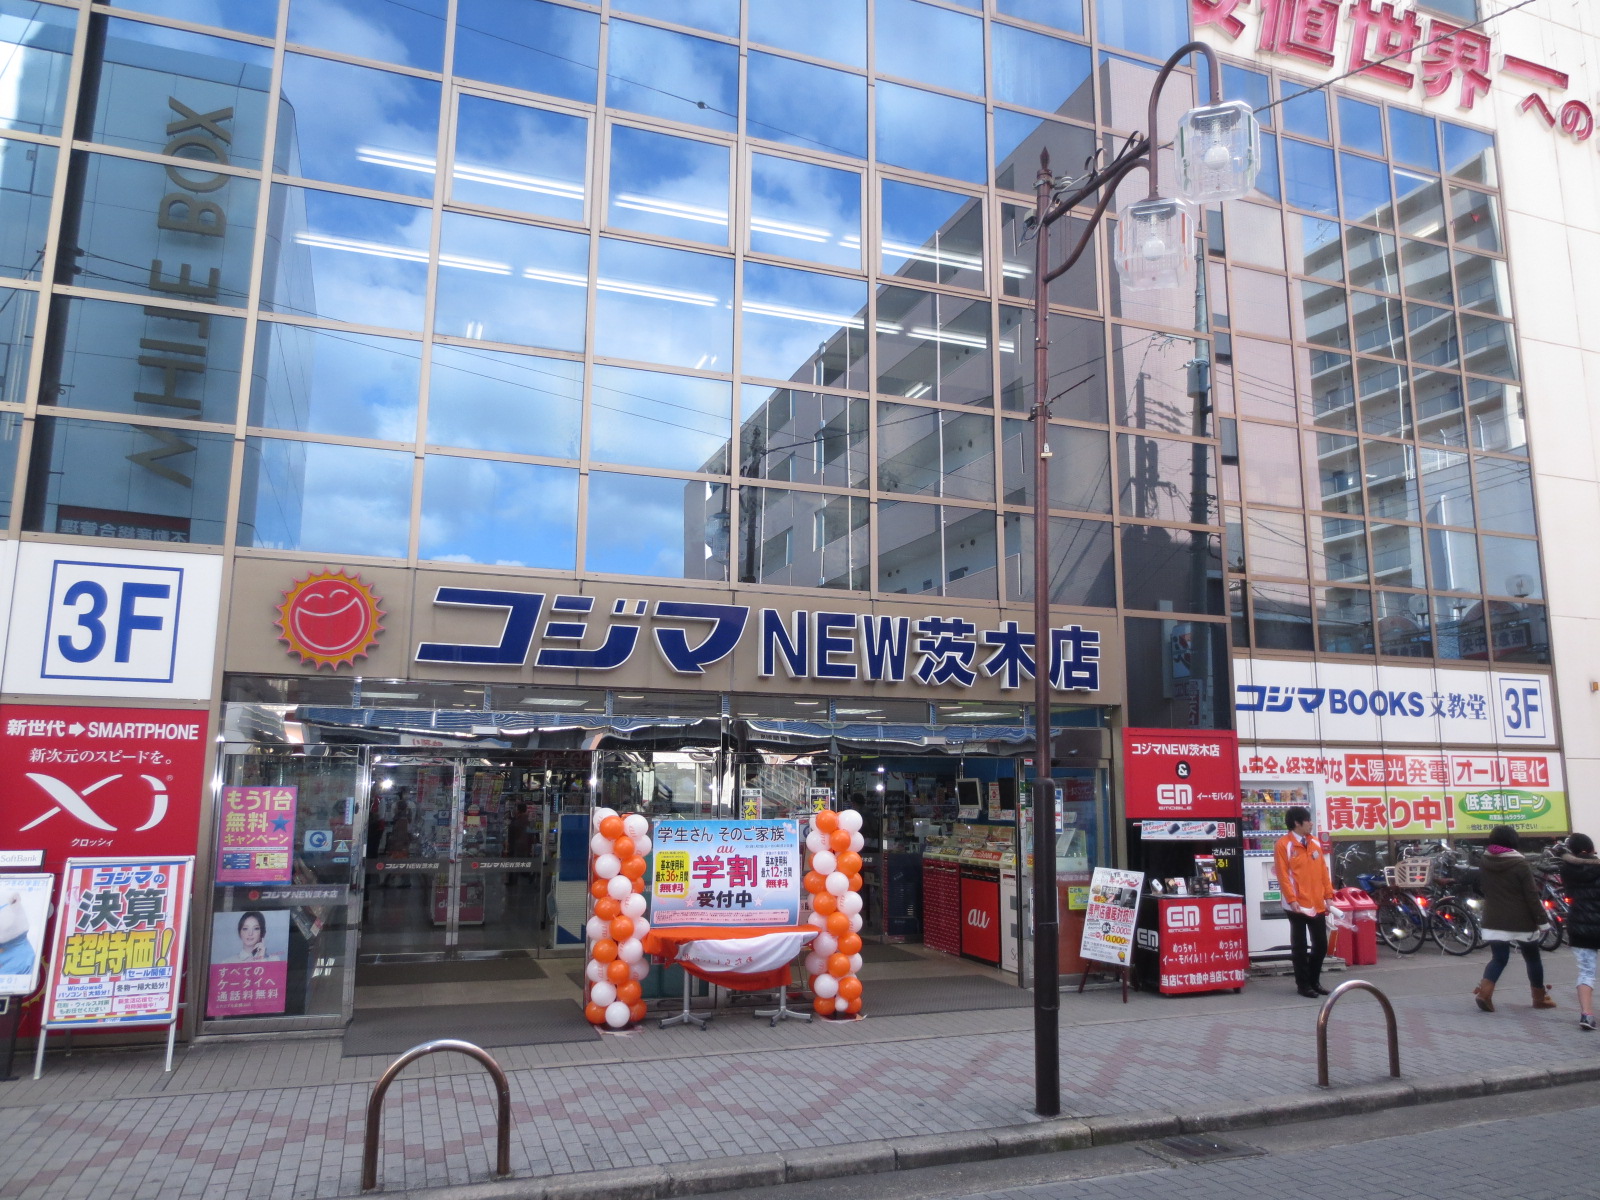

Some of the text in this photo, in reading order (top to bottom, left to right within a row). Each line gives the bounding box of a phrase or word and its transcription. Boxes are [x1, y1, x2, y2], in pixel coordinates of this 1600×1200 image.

[58, 580, 171, 663] 3F
[1506, 687, 1540, 730] 3F
[7, 718, 200, 741] 新世代 SMARTPHONE
[29, 748, 172, 765] 新次元のスピードを。
[1131, 742, 1220, 757] コジマNEW茨木店
[1177, 763, 1188, 776] &
[1456, 759, 1547, 784] オール電化
[226, 790, 293, 811] もう1台
[1465, 792, 1545, 812] 低金利ローン
[225, 811, 268, 833] 無料
[223, 833, 289, 845] キャンペーン
[657, 825, 786, 843] 学生さん そのご家族
[716, 844, 736, 854] au
[0, 854, 37, 863] SoftBank
[93, 871, 165, 886] コジマの
[691, 854, 758, 889] 学割
[659, 883, 685, 893] 無料
[765, 879, 789, 888] 無料
[696, 890, 753, 909] 受付中
[77, 888, 167, 931] 決算
[967, 908, 990, 929] au
[63, 928, 175, 977] 超特価!
[218, 966, 265, 977] すべての
[217, 978, 276, 990] ケータイへ
